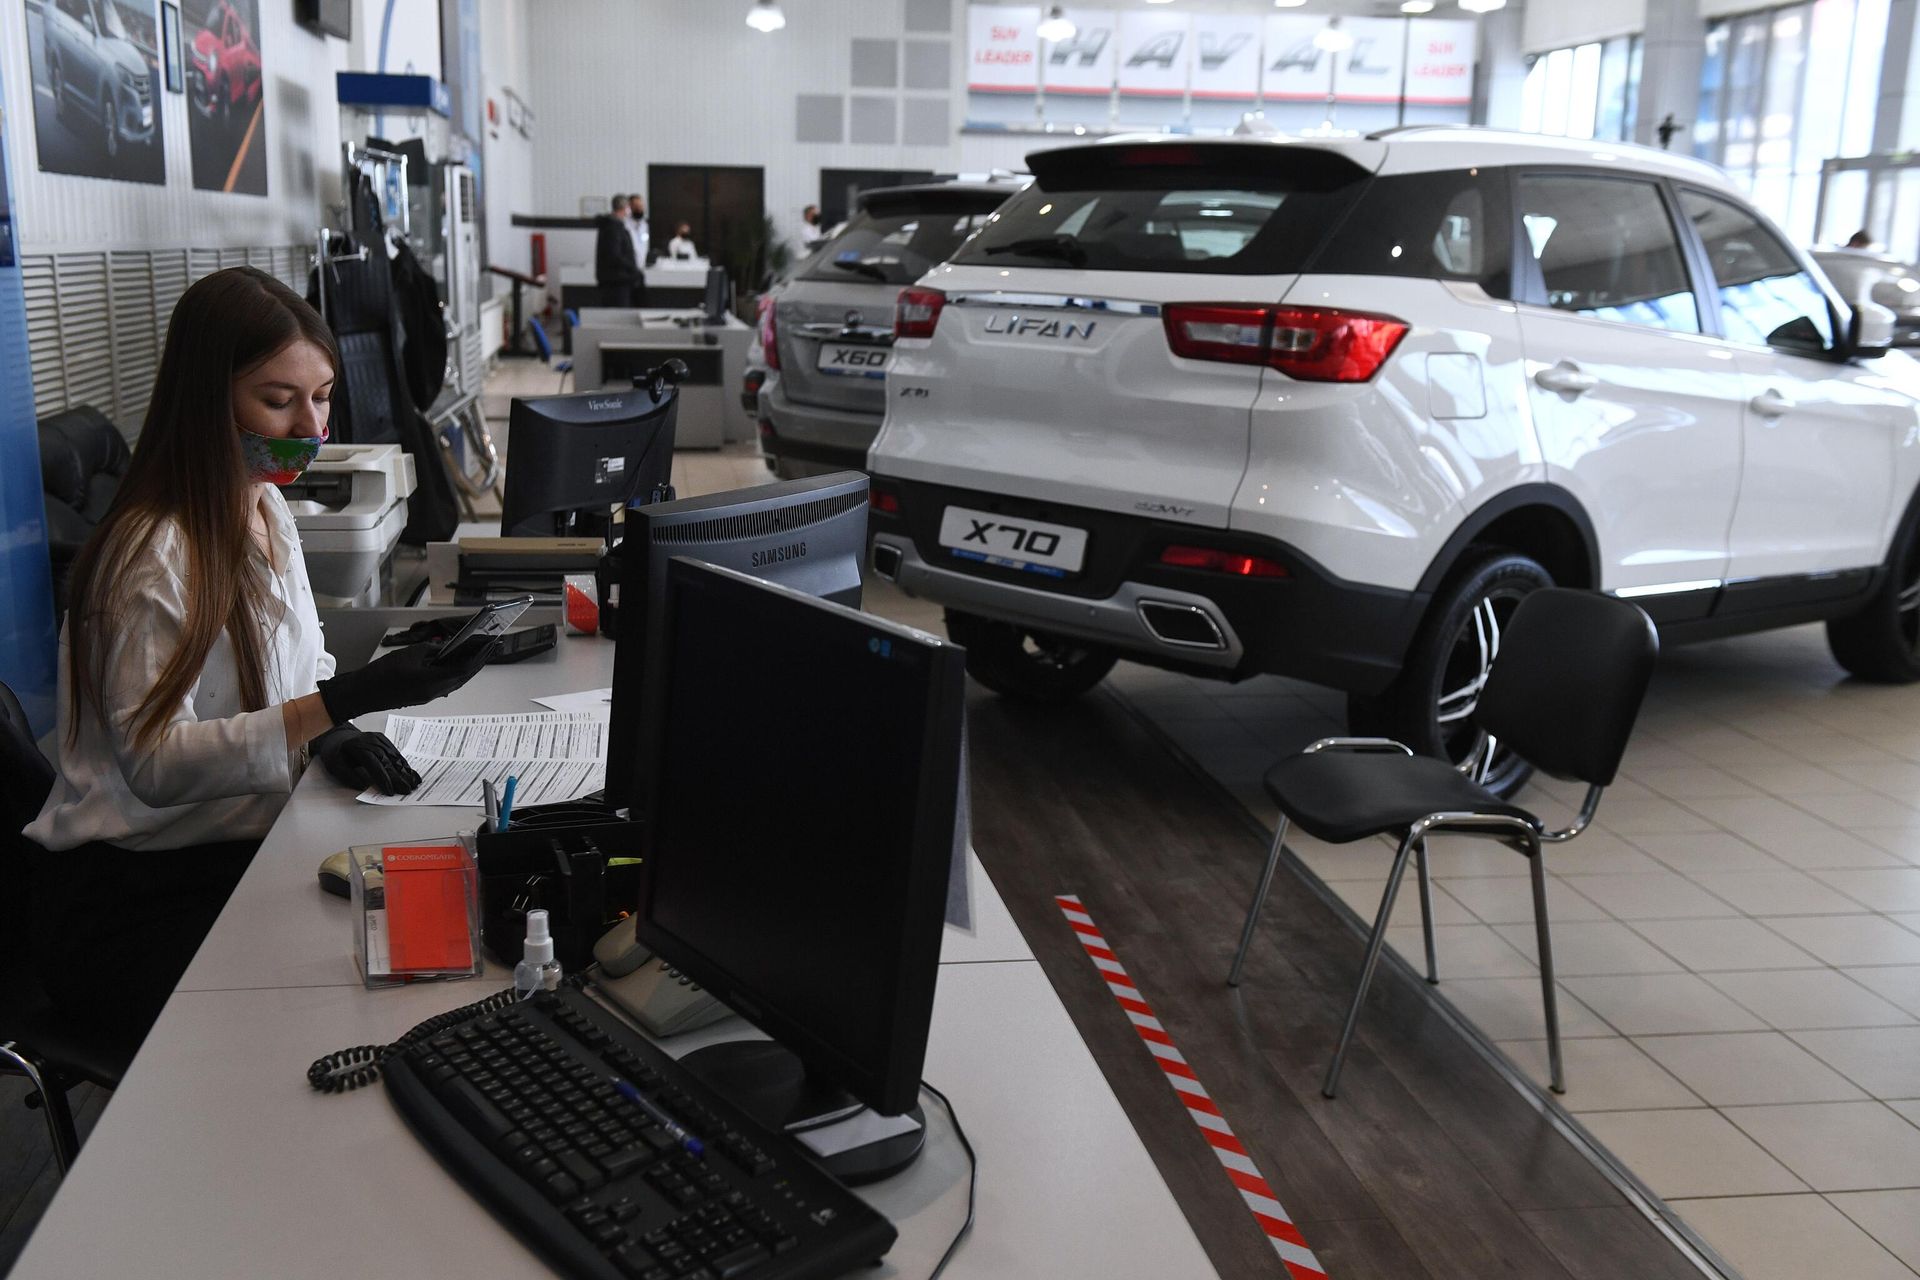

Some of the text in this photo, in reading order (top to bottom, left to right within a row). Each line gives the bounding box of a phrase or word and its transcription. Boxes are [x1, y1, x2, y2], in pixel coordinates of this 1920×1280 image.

[975, 51, 1032, 65] LEADER
[984, 315, 1097, 340] LIFAN
[831, 349, 888, 366] X60
[588, 399, 623, 411] ViewSonic
[963, 519, 1060, 557] X70
[752, 541, 806, 567] SAMSUNG
